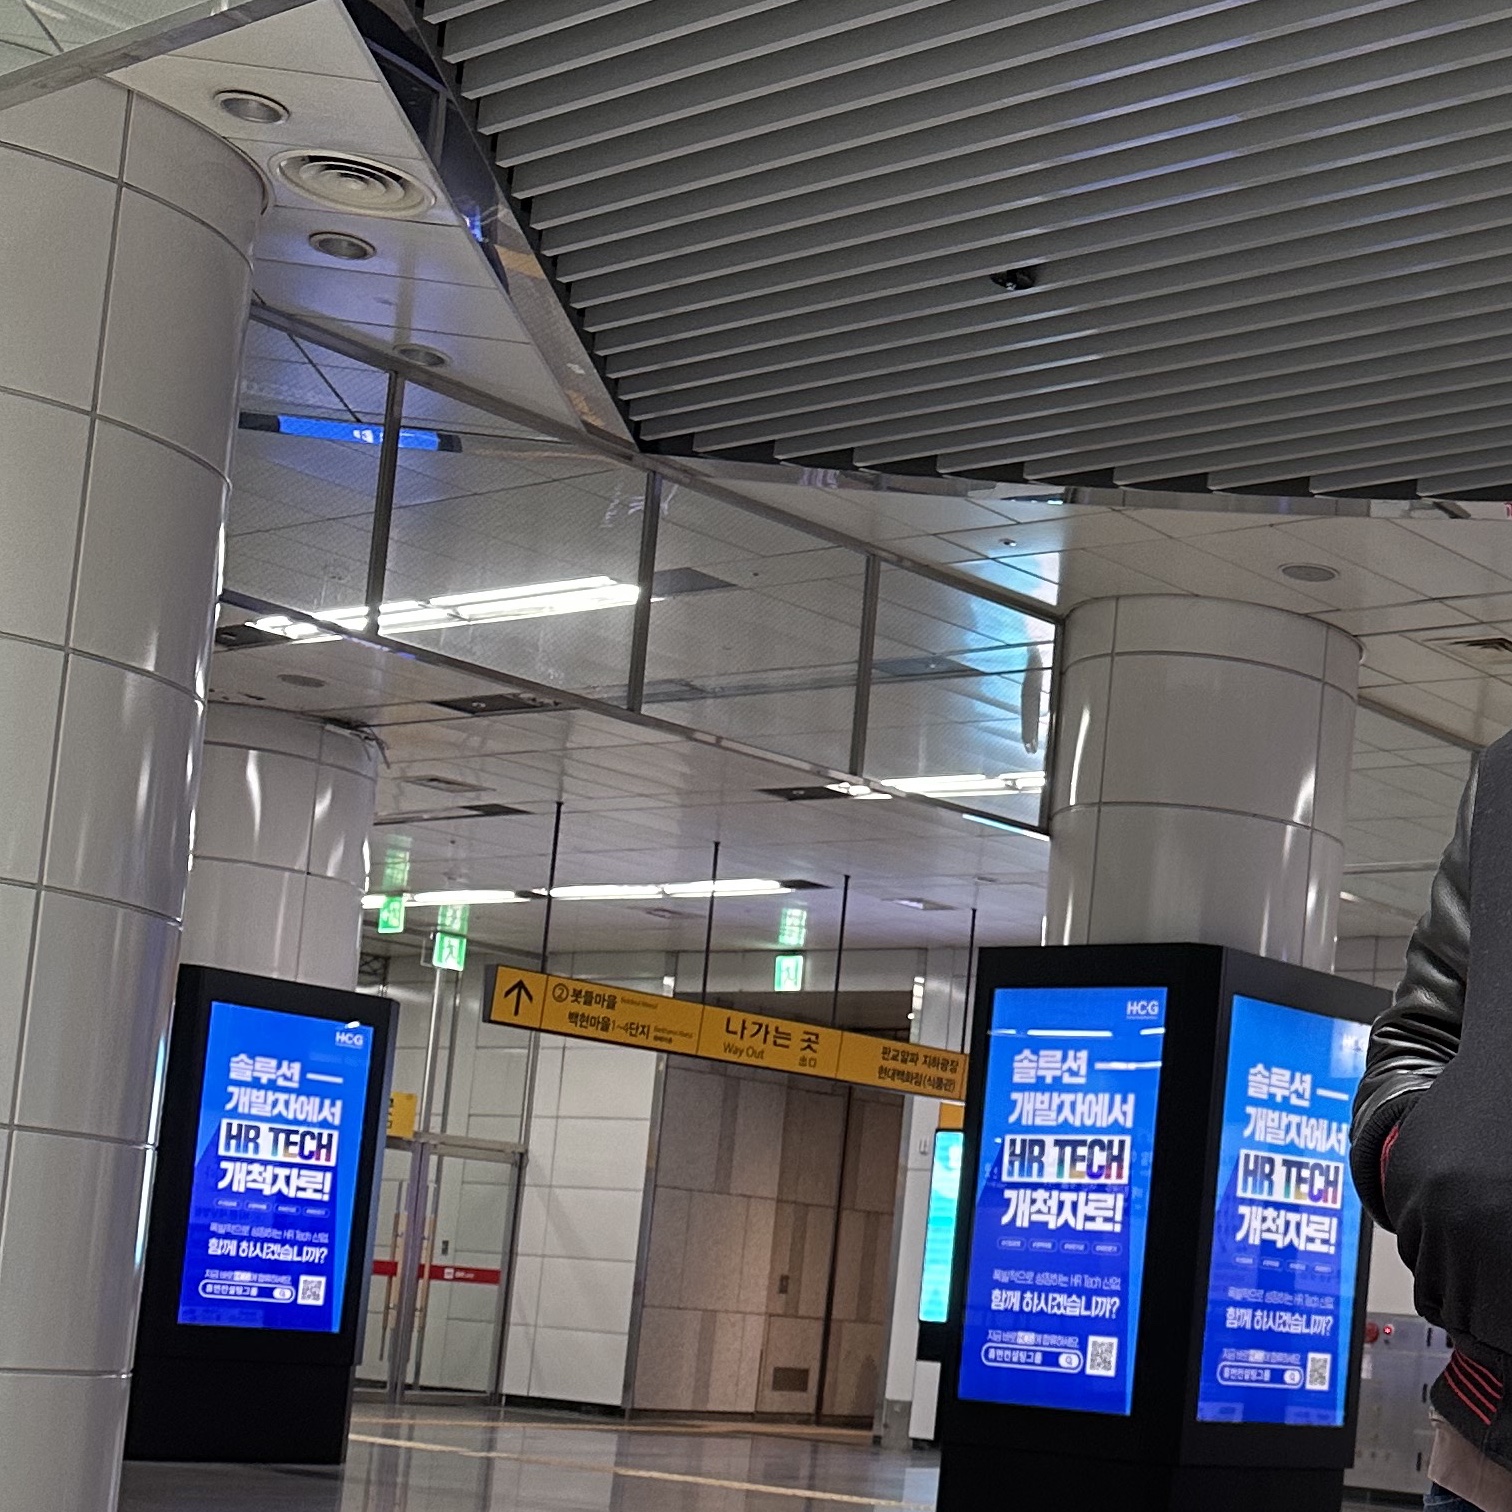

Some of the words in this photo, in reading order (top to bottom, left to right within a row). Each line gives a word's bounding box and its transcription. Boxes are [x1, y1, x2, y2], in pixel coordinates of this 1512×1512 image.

[1126, 1000, 1159, 1015] HCG
[335, 1031, 364, 1045] HCG
[723, 1042, 744, 1058] Way
[745, 1046, 765, 1060] Out
[725, 1016, 792, 1049] 나가는
[799, 1030, 820, 1053] 곳
[229, 1053, 301, 1089] 솔루션
[1012, 1048, 1088, 1084] 솔루션
[1247, 1063, 1312, 1107] 솔루션
[224, 1085, 343, 1126] 개발자에서
[1008, 1091, 1135, 1128] 개발자에서
[224, 1122, 261, 1155] HR
[268, 1127, 333, 1162] TECH
[1243, 1106, 1349, 1156] 개발자에서
[1007, 1137, 1046, 1179] HR
[1053, 1137, 1127, 1180] TECH
[217, 1160, 333, 1202] 개척자로!
[1242, 1153, 1275, 1197] HR
[1282, 1158, 1340, 1205] TECH
[1000, 1188, 1124, 1233] 개척자로!
[1235, 1204, 1338, 1255] 개척자로!
[208, 1237, 238, 1257] 함께
[239, 1240, 328, 1264] 하시겠습니까?
[990, 1288, 1021, 1312] 함께
[1022, 1291, 1121, 1319] 하시겠습니까?
[1226, 1306, 1252, 1330] 함께
[1254, 1309, 1334, 1336] 하시겠습니까?
